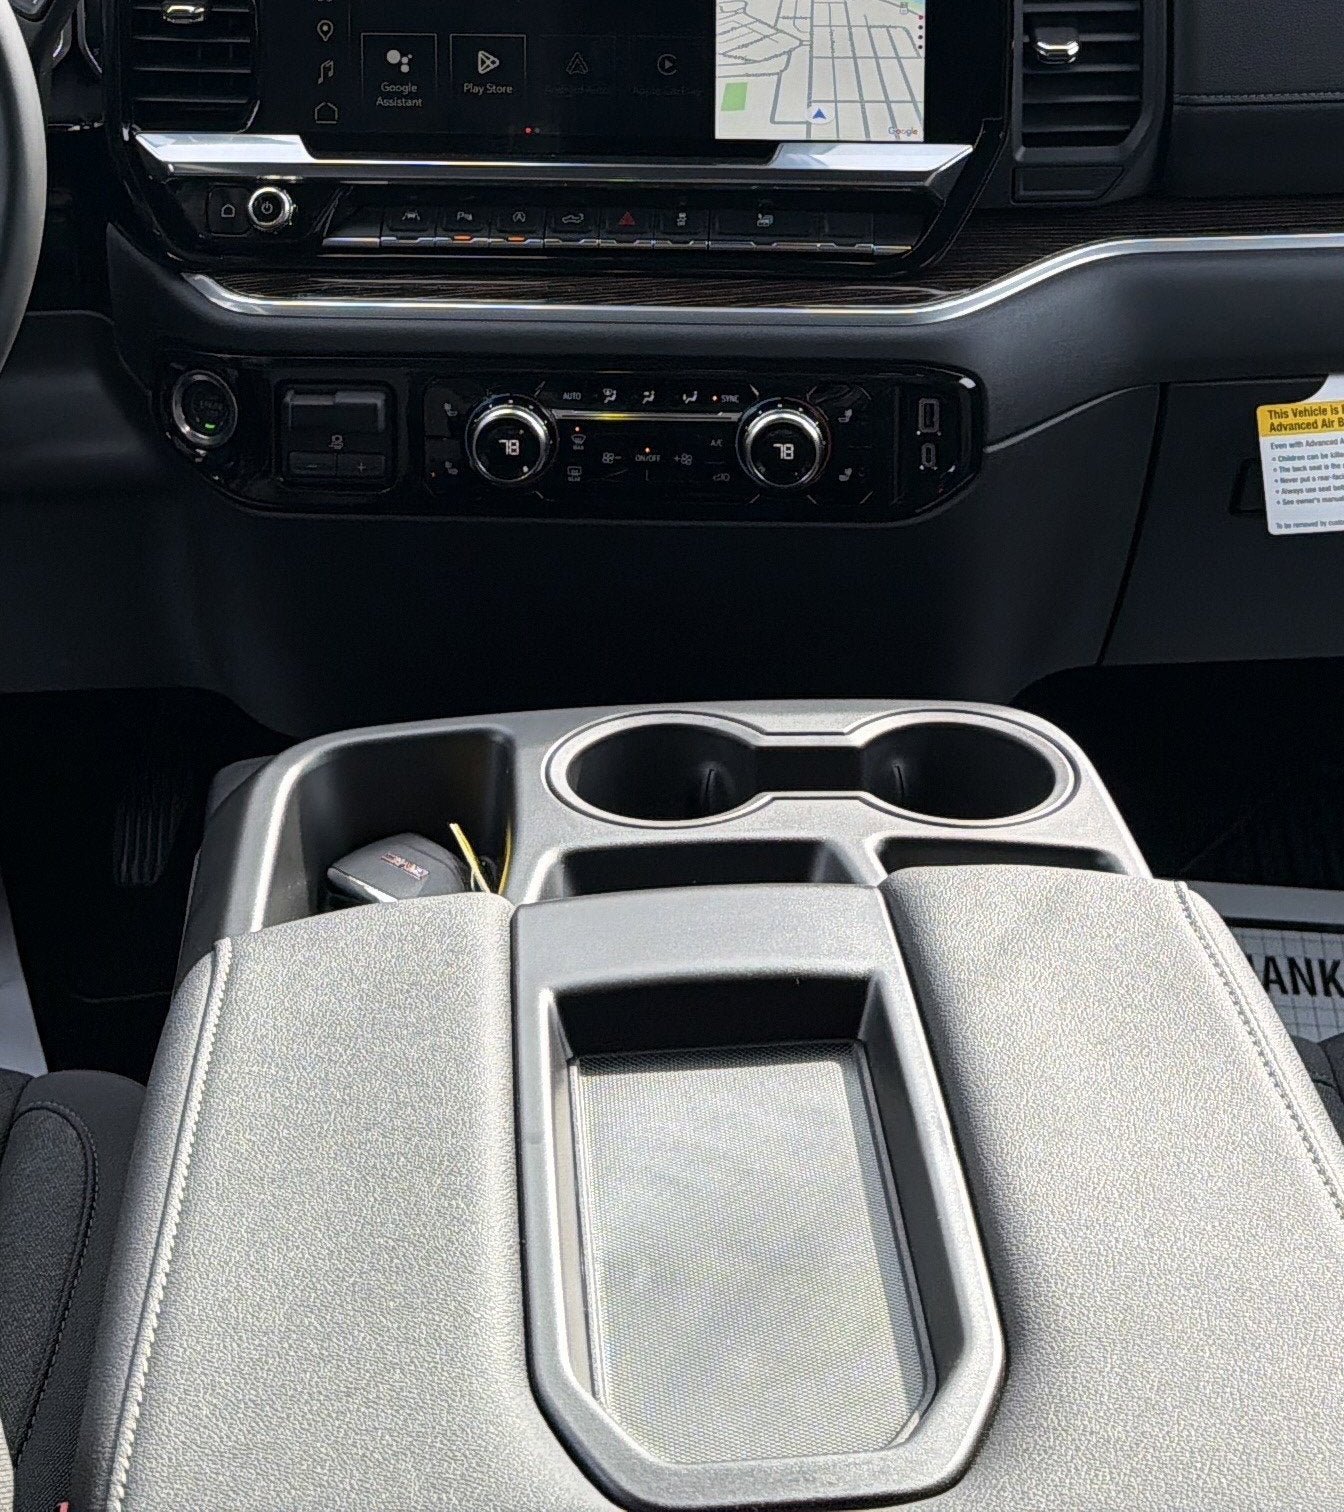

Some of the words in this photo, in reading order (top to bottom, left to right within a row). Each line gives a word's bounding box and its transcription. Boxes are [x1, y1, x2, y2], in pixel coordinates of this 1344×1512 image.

[380, 81, 418, 95] Google
[464, 82, 484, 96] Play
[486, 83, 513, 94] Store
[376, 96, 423, 107] Assistant
[888, 126, 919, 137] Google
[562, 391, 582, 400] AUTO
[721, 394, 740, 404] SYNC
[1268, 409, 1289, 421] This
[1291, 405, 1328, 418] Vehicle
[1269, 419, 1319, 433] Advanced
[1321, 417, 1335, 429] Air
[498, 439, 520, 456] 78
[710, 439, 723, 447] A/C
[773, 443, 795, 460] 78
[634, 454, 661, 463] ON/OFF
